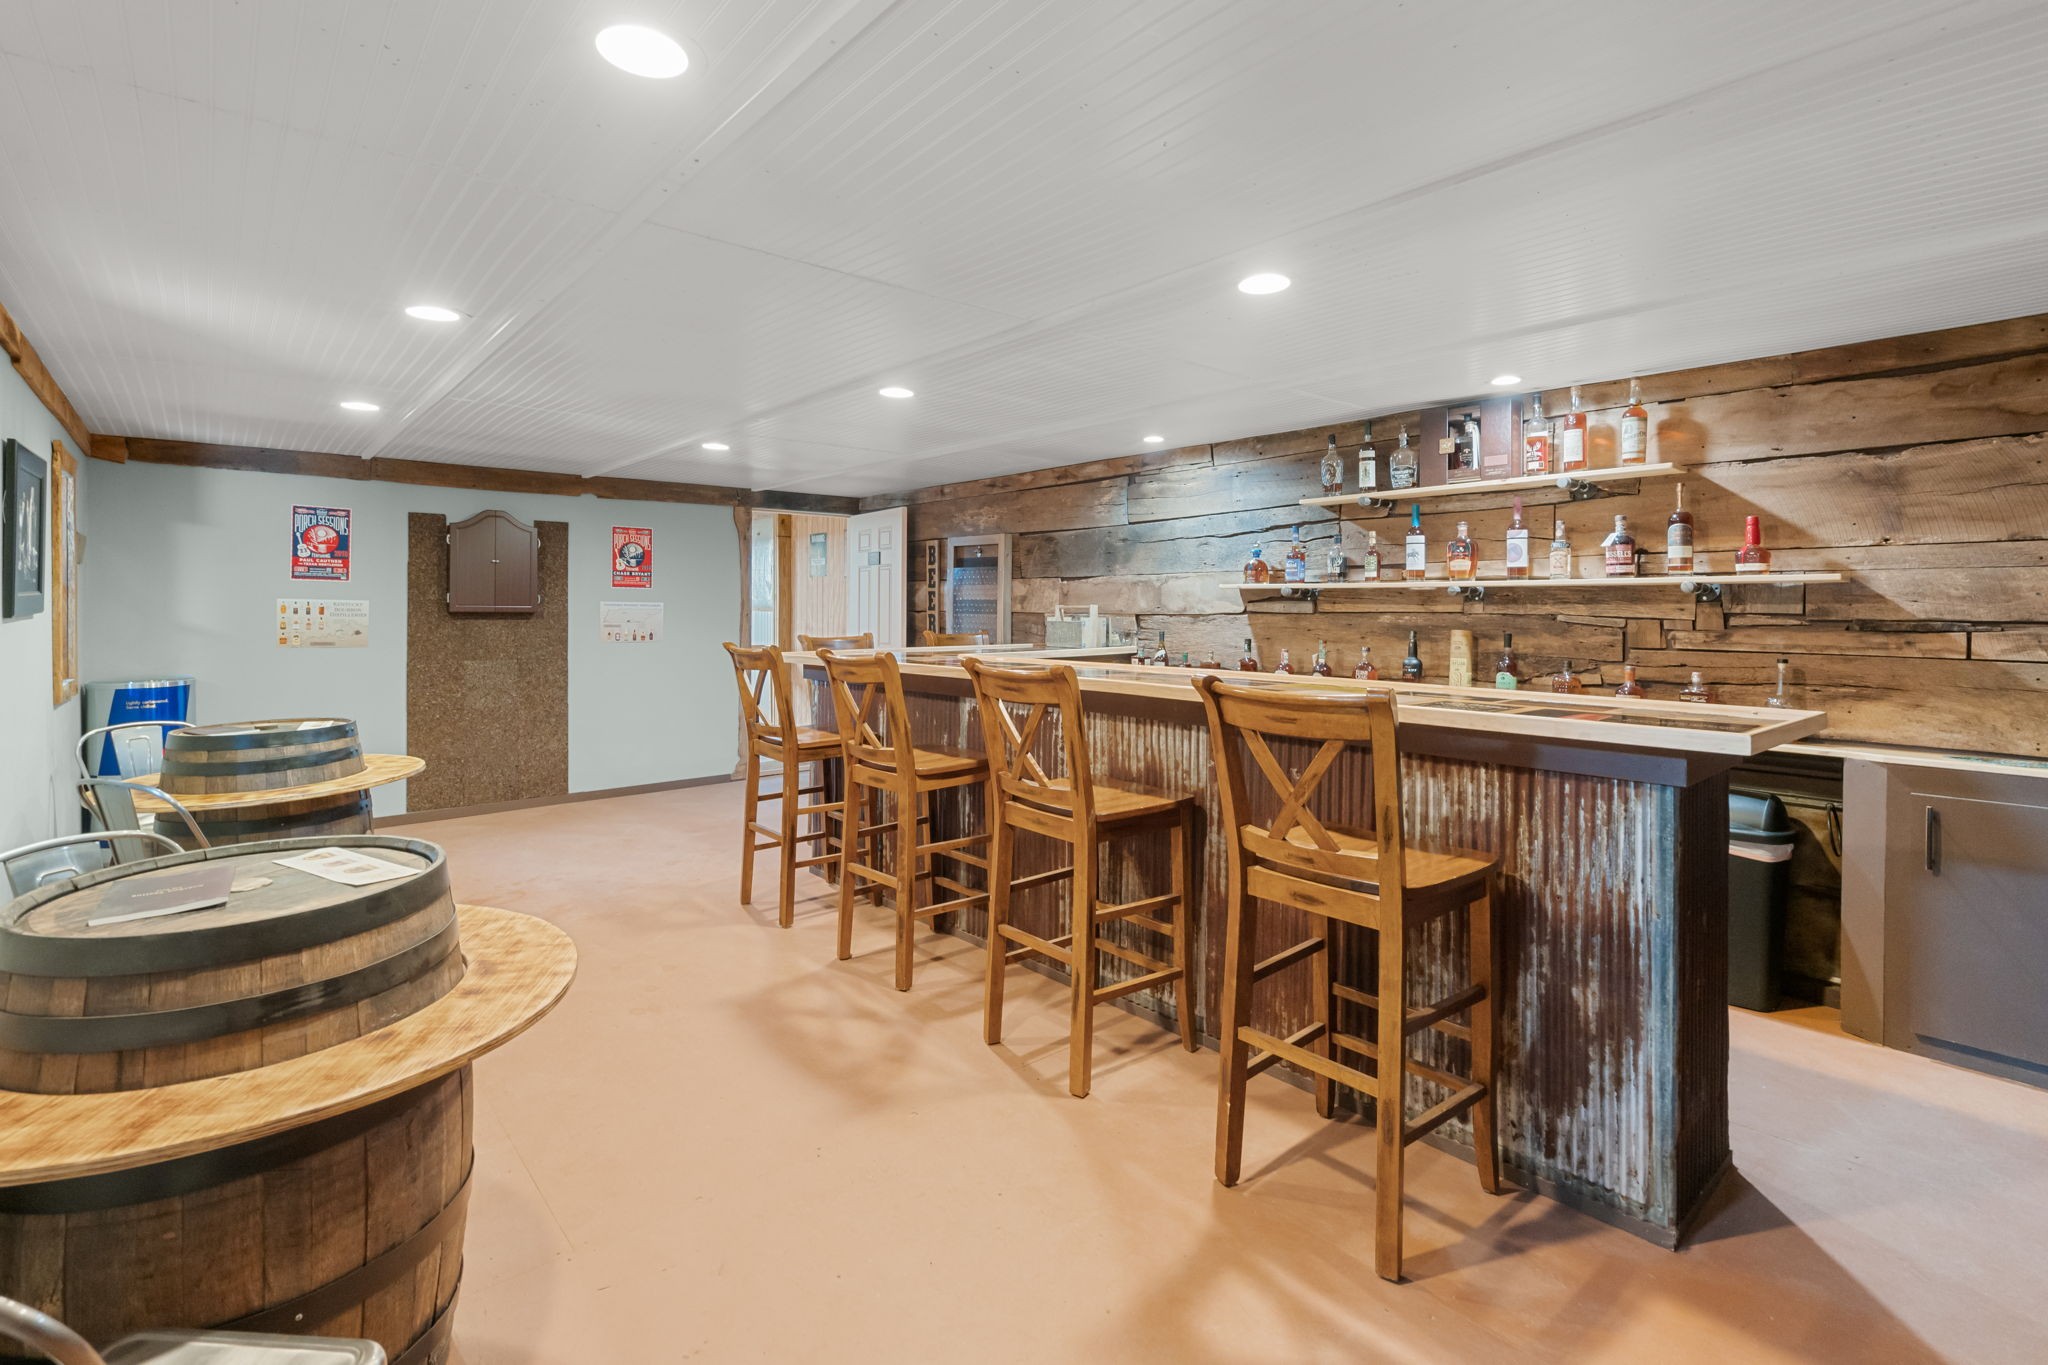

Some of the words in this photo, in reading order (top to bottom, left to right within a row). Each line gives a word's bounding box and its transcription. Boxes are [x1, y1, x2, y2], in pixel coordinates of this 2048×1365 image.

[294, 514, 317, 533] PORCH
[317, 515, 349, 535] SESSIONS
[928, 546, 936, 634] BEER
